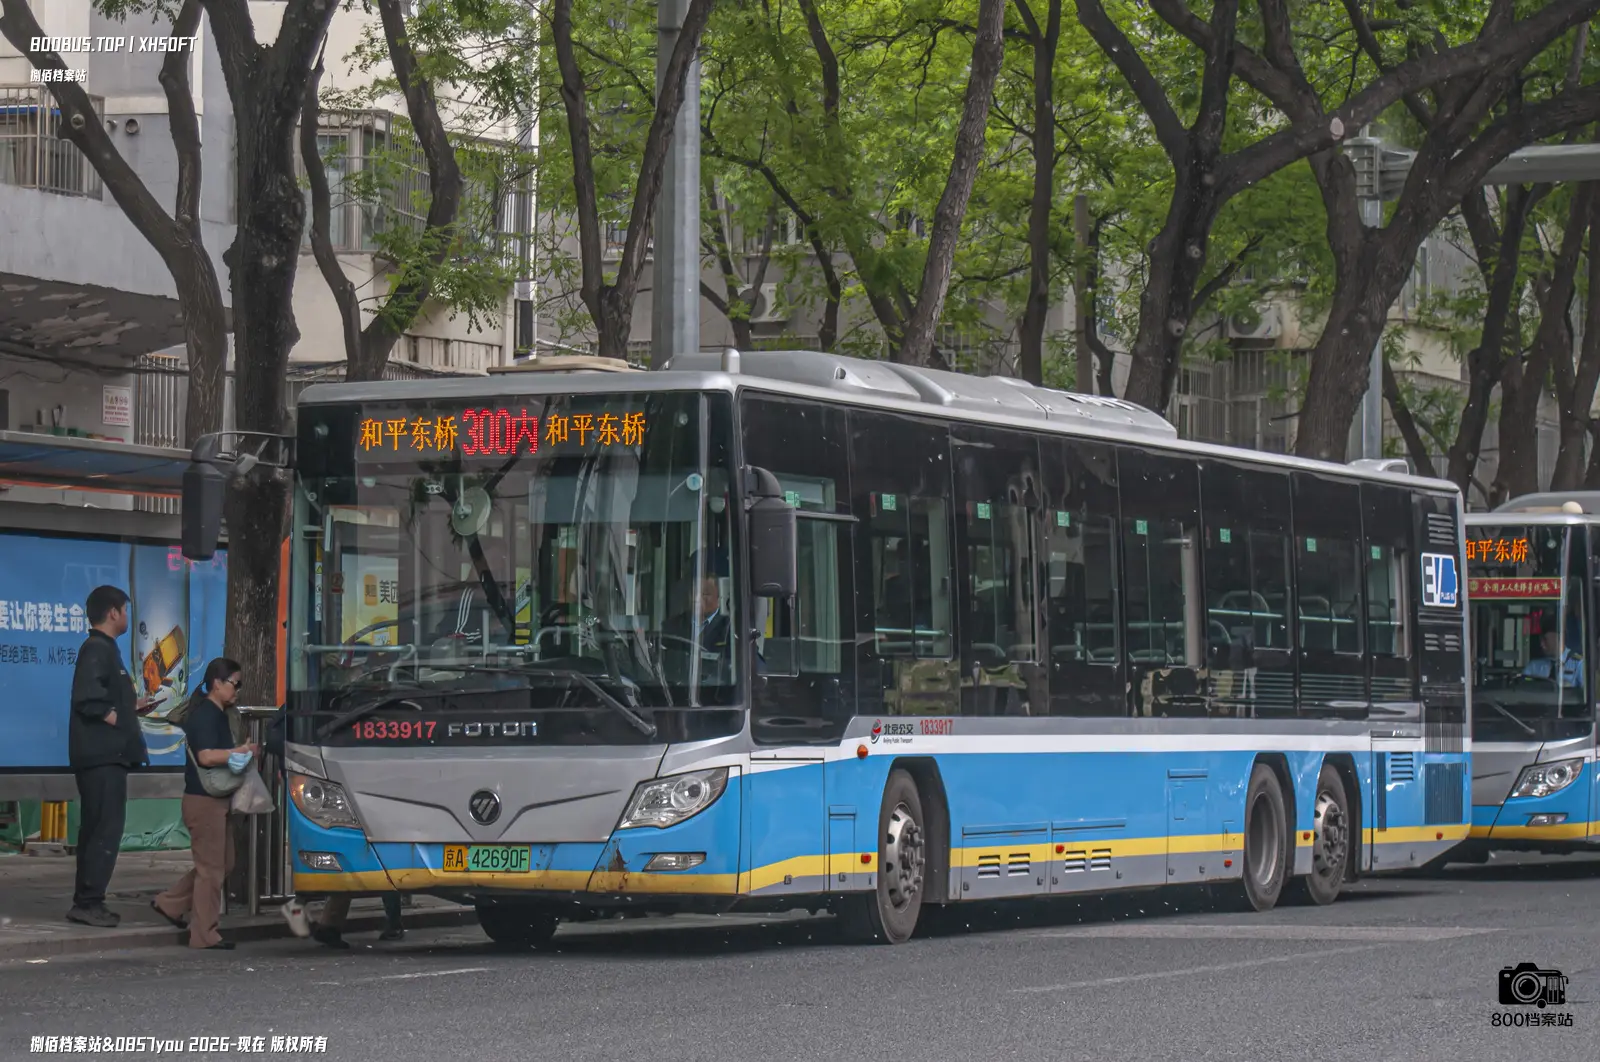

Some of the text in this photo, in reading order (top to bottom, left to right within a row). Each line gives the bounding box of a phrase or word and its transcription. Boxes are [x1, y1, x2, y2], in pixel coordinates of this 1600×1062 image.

[359, 408, 646, 455] 和平东桥 300内 和平东桥
[0, 600, 92, 634] 要让你我生命
[352, 721, 437, 739] 1833917
[448, 722, 538, 737] FOTON
[884, 723, 914, 736] 北京公交
[919, 719, 954, 735] 1833917
